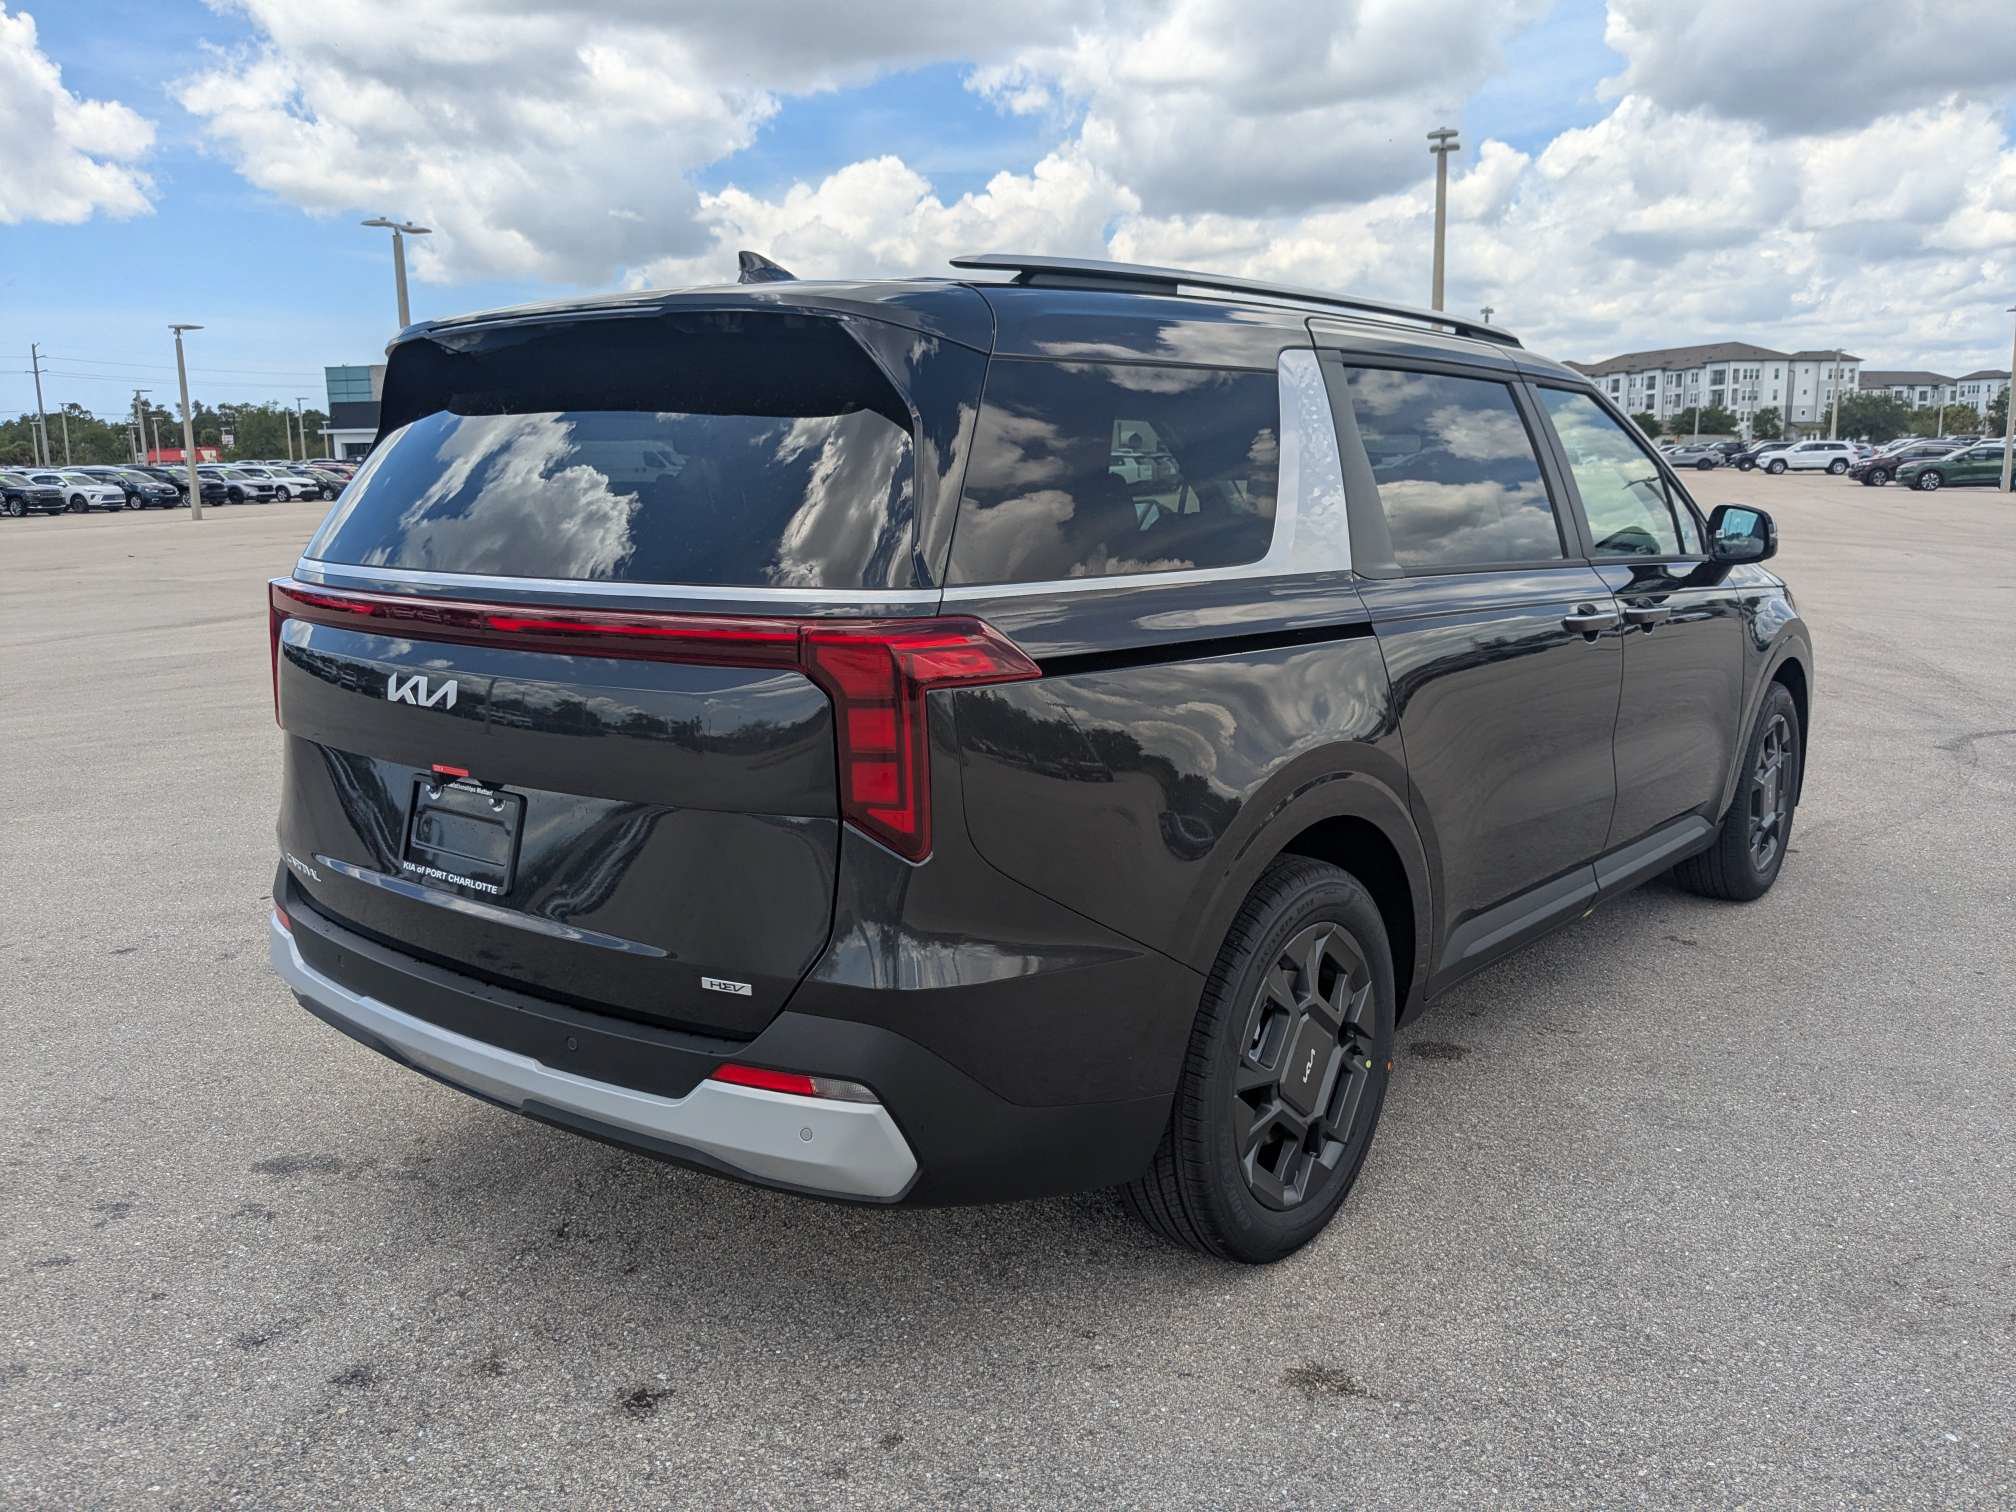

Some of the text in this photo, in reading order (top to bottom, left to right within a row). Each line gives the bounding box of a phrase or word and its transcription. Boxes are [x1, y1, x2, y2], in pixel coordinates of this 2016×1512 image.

[387, 671, 458, 710] KIA
[403, 861, 498, 894] KIA of PORT CHARLOTTE
[708, 979, 747, 993] HEV
